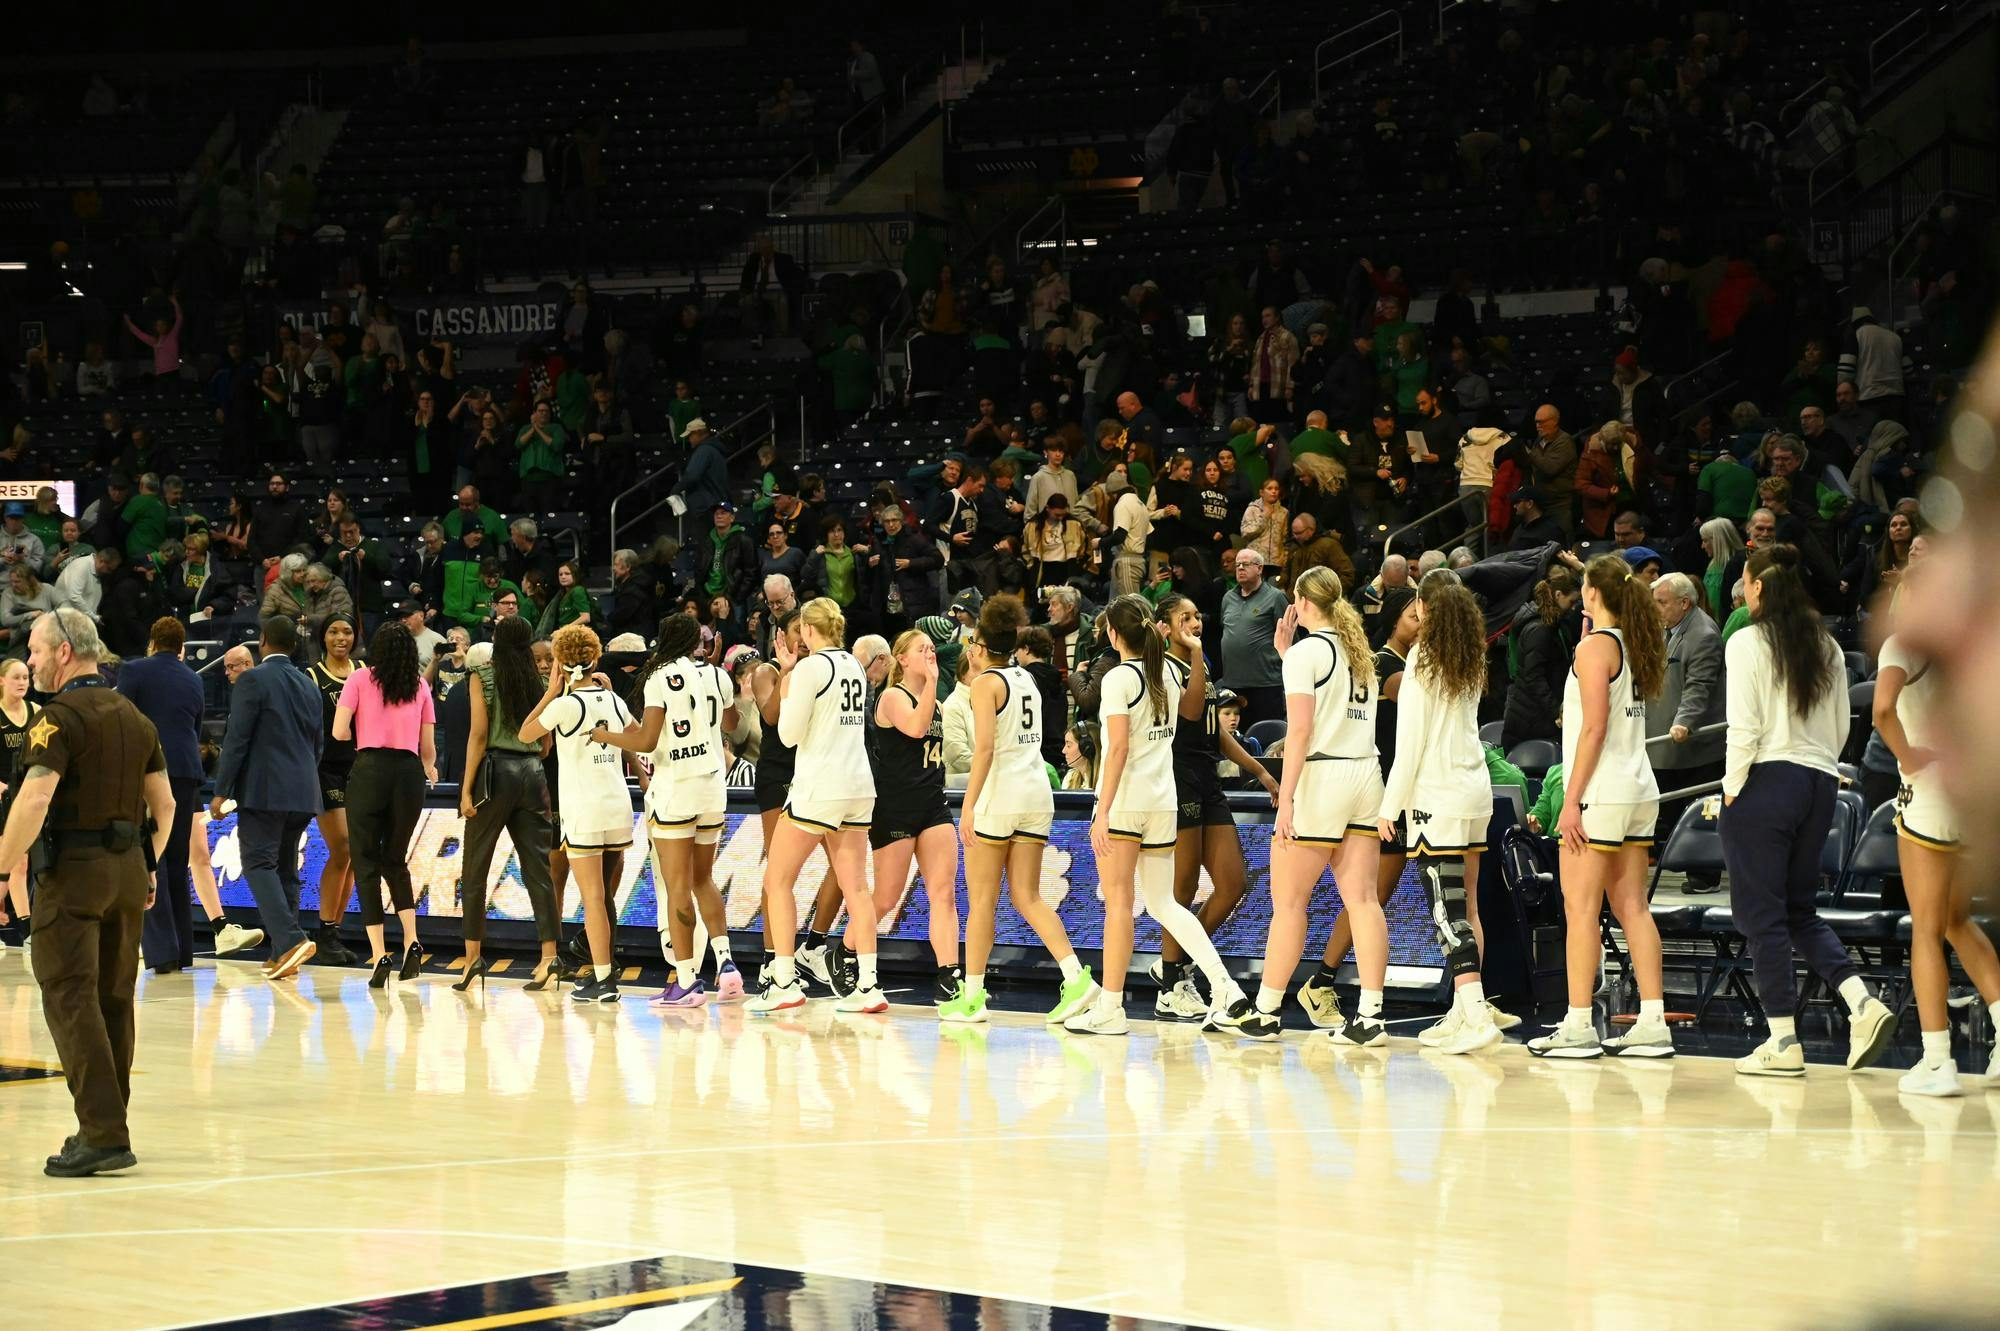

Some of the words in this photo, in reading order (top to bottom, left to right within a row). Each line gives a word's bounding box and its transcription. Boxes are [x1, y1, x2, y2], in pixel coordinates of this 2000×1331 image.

[415, 304, 557, 336] CASSANDRE
[841, 679, 863, 712] 32
[1022, 695, 1033, 730] 5
[1206, 704, 1216, 735] 11
[923, 740, 941, 768] 14
[1018, 733, 1041, 745] MILES
